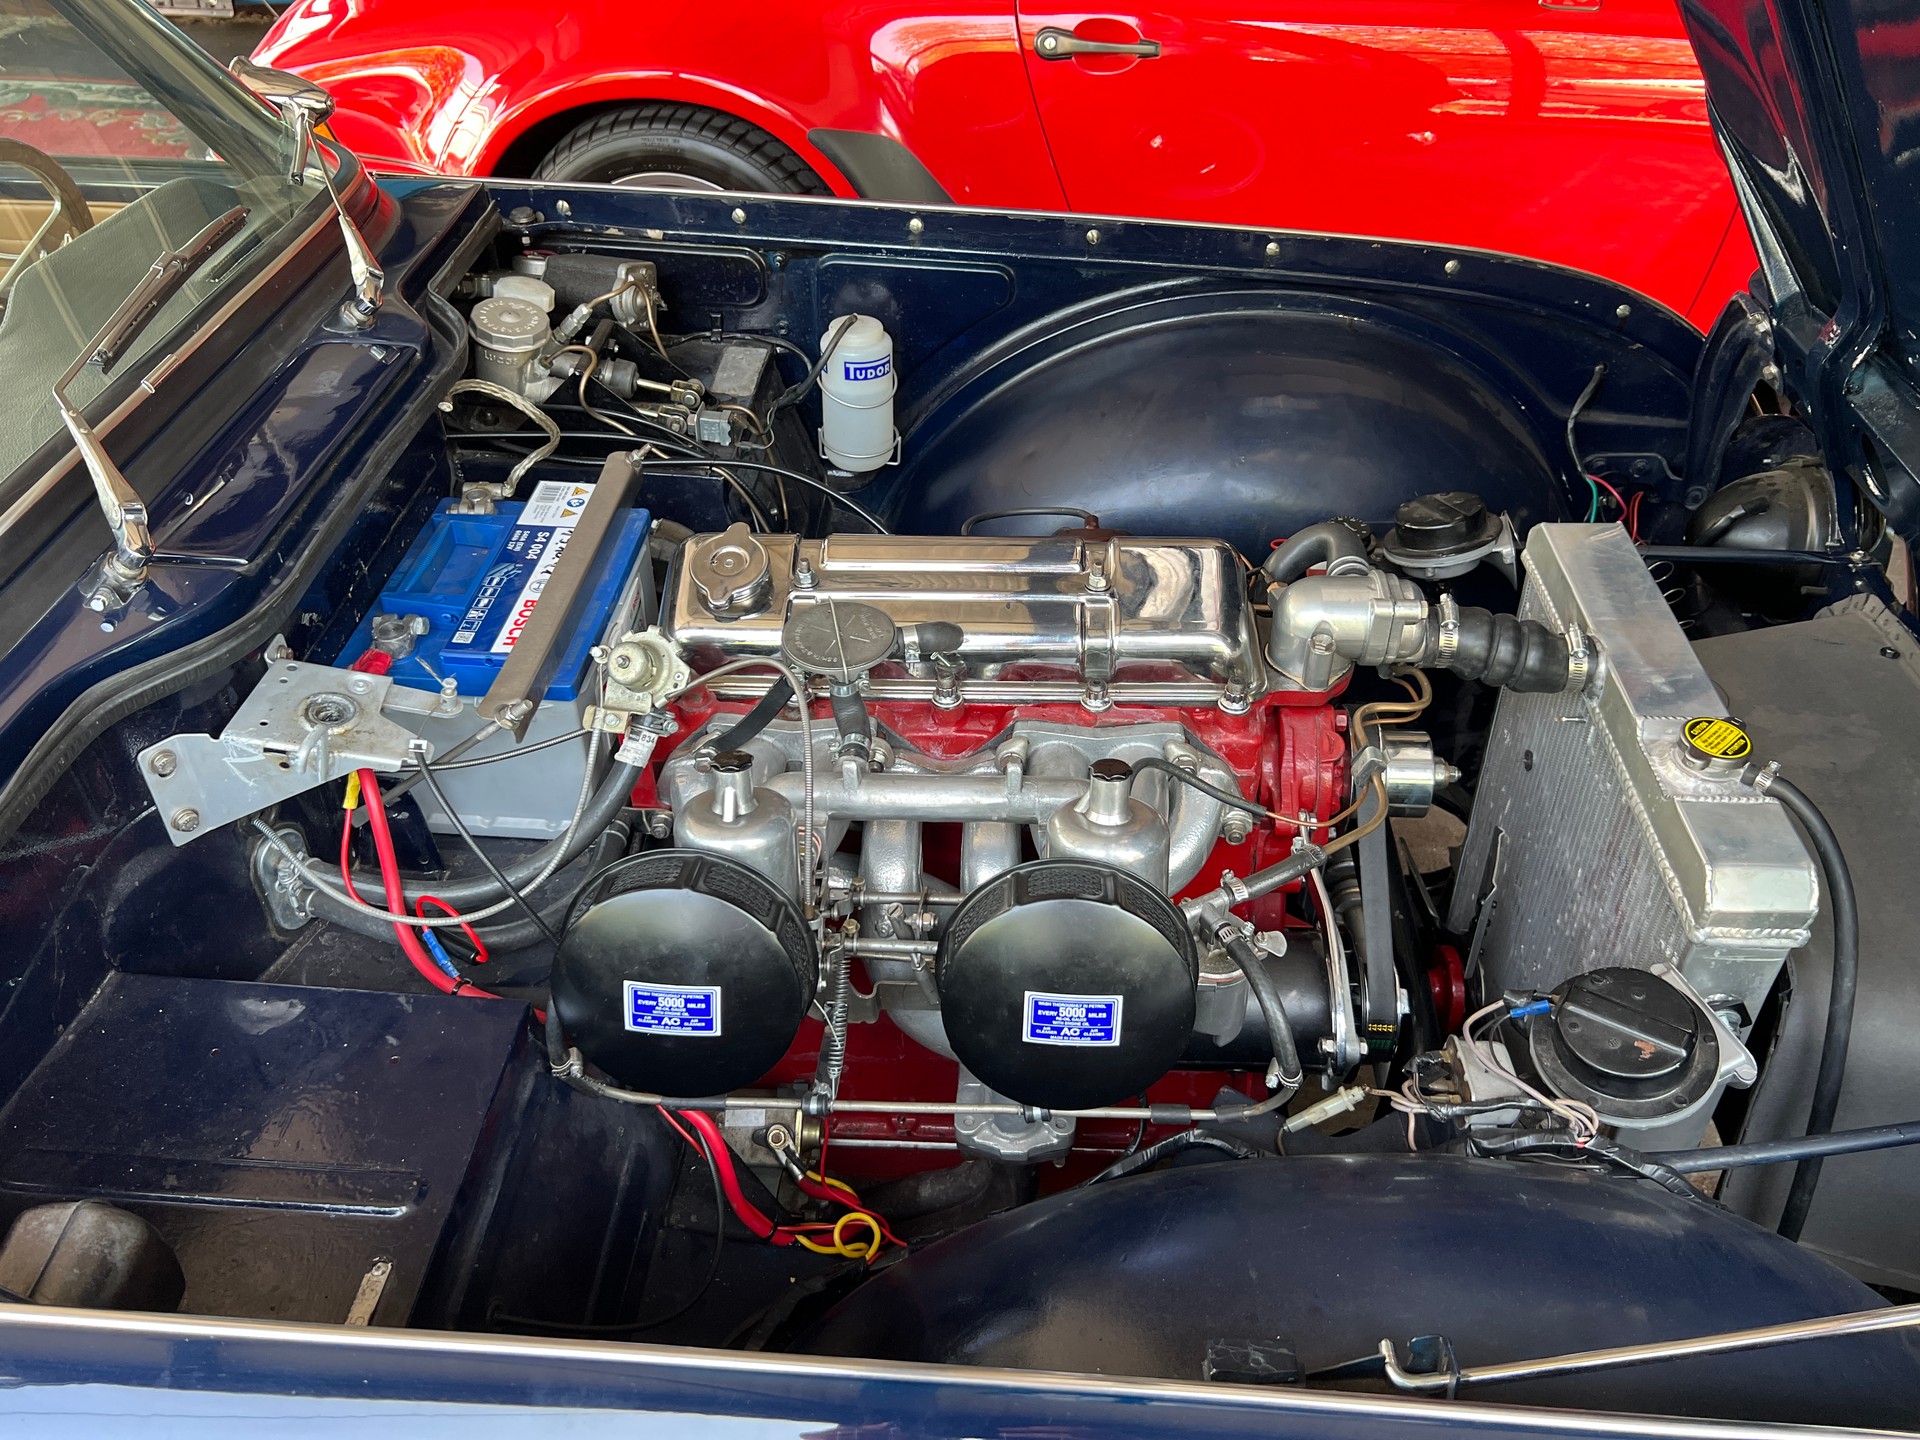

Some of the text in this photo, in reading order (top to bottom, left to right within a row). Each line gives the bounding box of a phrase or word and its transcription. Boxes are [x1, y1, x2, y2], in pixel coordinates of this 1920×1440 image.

[846, 357, 890, 380] TUDOR
[534, 531, 550, 543] S4
[525, 543, 543, 560] 004
[658, 997, 685, 1008] 5000
[1059, 1007, 1086, 1018] 5000
[661, 1017, 680, 1025] AC
[1060, 1027, 1080, 1036] AC
